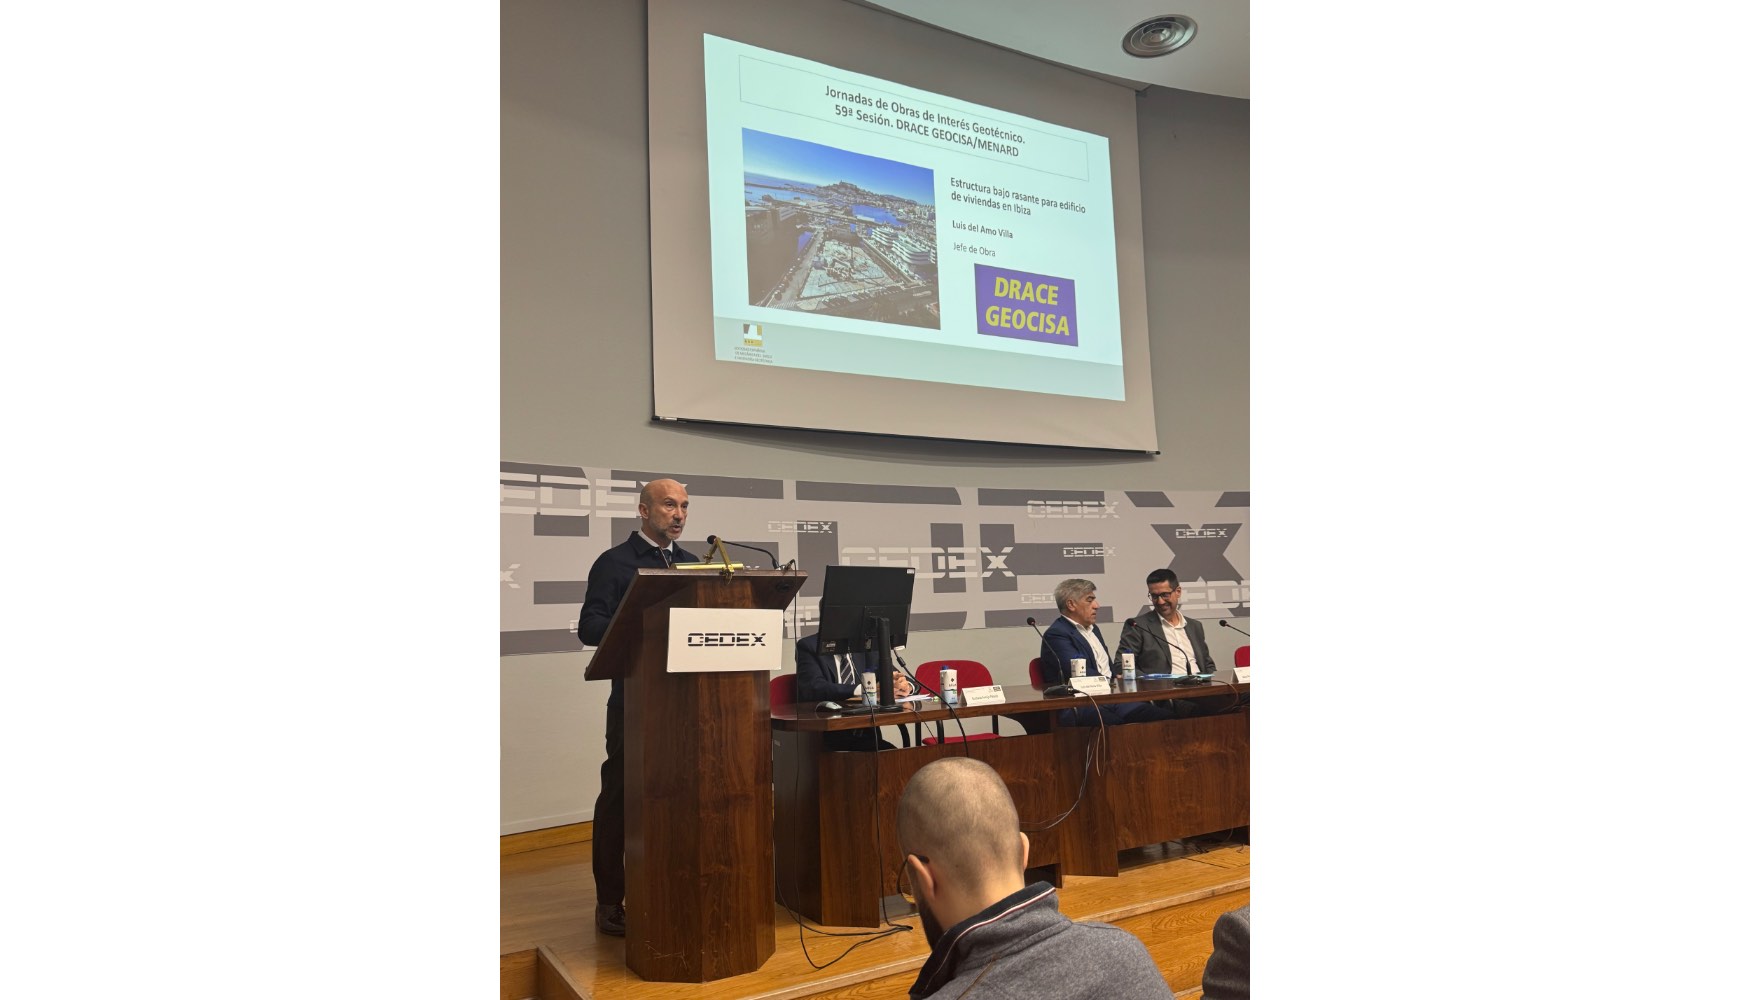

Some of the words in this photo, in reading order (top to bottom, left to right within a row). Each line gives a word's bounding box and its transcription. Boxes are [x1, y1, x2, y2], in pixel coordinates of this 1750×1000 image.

[825, 85, 872, 107] Jornadas
[876, 98, 888, 111] de
[891, 102, 920, 119] Obras
[923, 110, 934, 122] de
[937, 113, 970, 131] Interés
[973, 123, 1026, 144] Geotécnico.
[835, 104, 853, 117] 59ª
[856, 110, 894, 128] Sesión.
[896, 119, 929, 137] DRACE
[932, 128, 1019, 157] GEOCISA/MENARD
[950, 177, 991, 194] Estructura
[993, 186, 1010, 199] bajo
[1012, 192, 1040, 204] rasante
[1041, 198, 1058, 208] para
[1060, 201, 1086, 214] edificio
[951, 191, 961, 201] de
[963, 194, 1000, 209] viviendas
[1002, 203, 1012, 211] en
[1014, 203, 1031, 215] Ibiza
[952, 220, 966, 230] Luis
[967, 223, 979, 233] del
[980, 225, 997, 236] Amo
[998, 228, 1013, 239] Villa
[953, 242, 967, 252] Jefe
[968, 244, 978, 254] de
[979, 246, 996, 257] Obra
[994, 276, 1058, 305] DRACE
[985, 305, 1070, 336] GEOCISA
[1027, 500, 1120, 519] CEDEX
[767, 520, 833, 534] CEDEX
[1175, 528, 1229, 539] CEDEX
[1063, 546, 1116, 558] CEDEX
[687, 632, 767, 647] CEDEX
